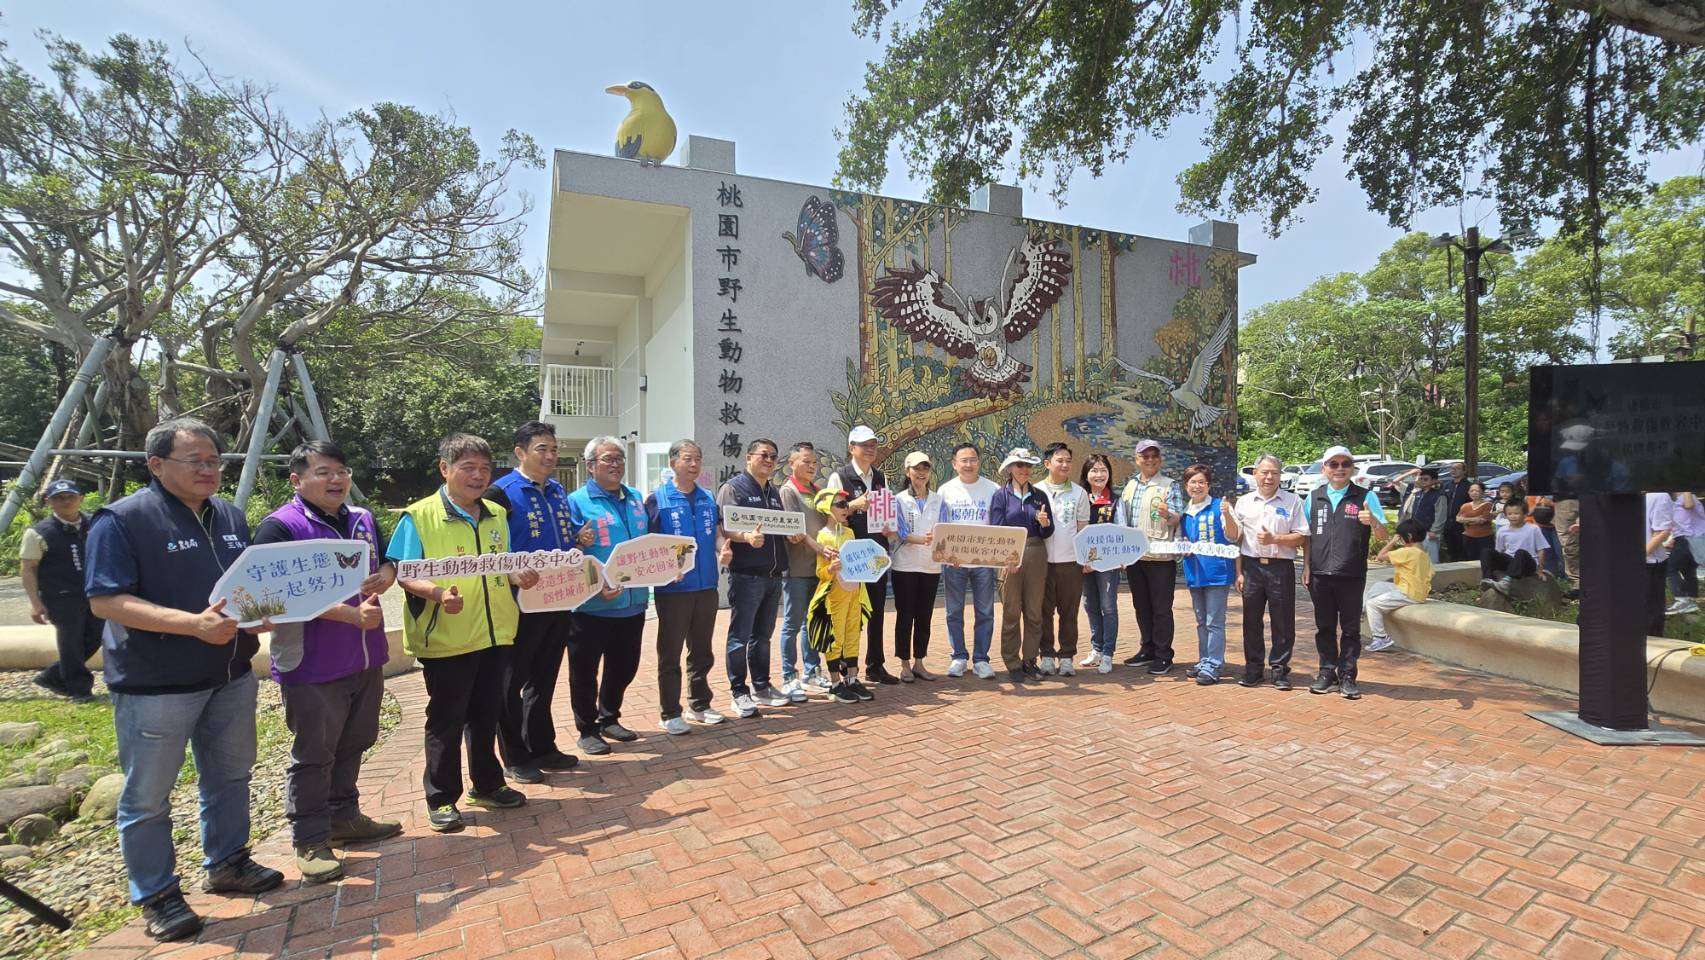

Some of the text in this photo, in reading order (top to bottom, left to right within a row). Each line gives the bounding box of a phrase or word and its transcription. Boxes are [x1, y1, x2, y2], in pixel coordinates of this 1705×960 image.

[247, 551, 331, 582] 守護生態
[402, 551, 581, 578] 野生動物救傷收容中心
[635, 560, 677, 577] 安心回家
[263, 572, 345, 599] 一起努力
